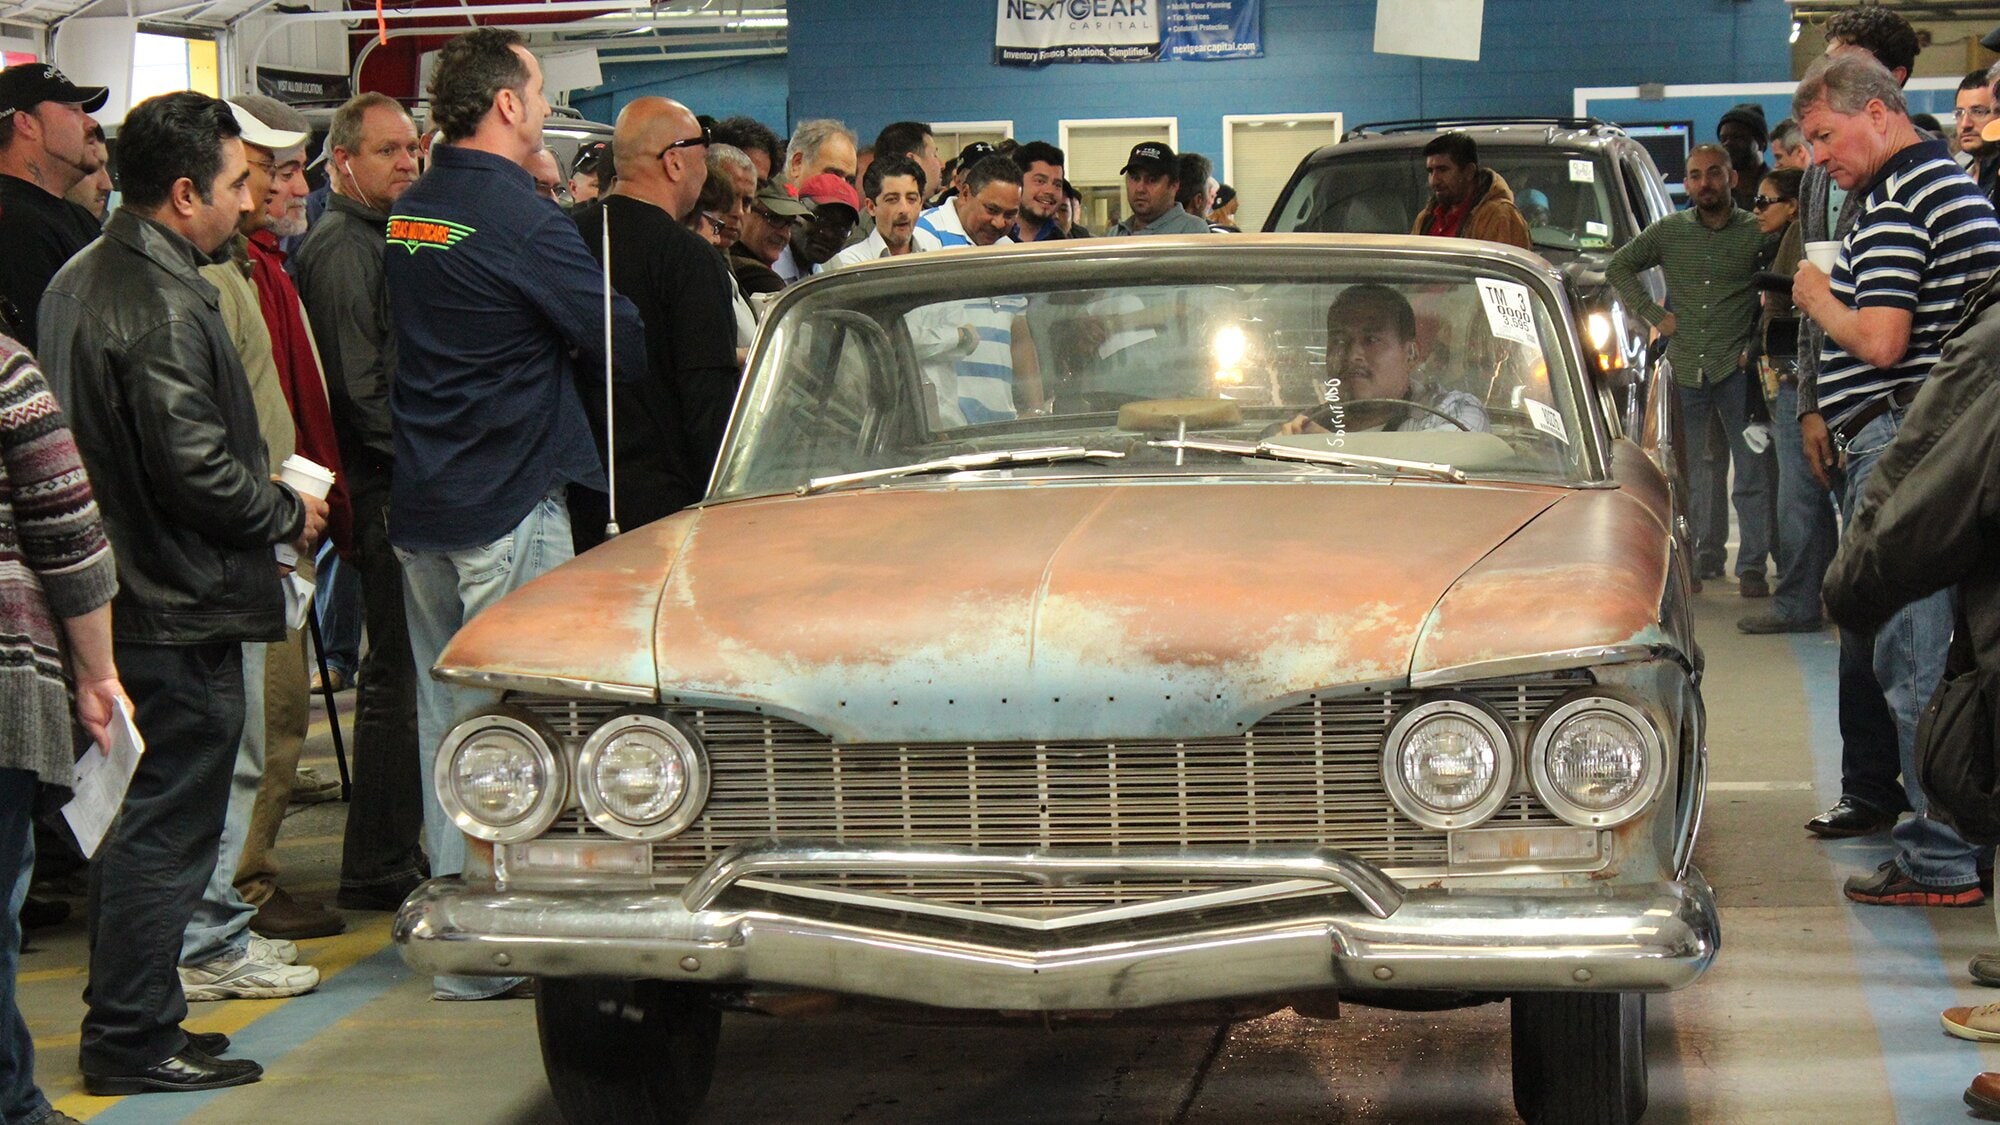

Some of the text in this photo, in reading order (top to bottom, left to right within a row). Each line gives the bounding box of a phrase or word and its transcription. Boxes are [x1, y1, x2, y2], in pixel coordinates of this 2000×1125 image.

[1006, 0, 1146, 20] NEXTGEAR
[1206, 1, 1232, 9] Planning
[1199, 23, 1229, 31] Protection
[1172, 41, 1256, 54] nextgearcapital.com
[1003, 49, 1038, 61] Inventory
[303, 82, 324, 95] LOCATIONS
[1485, 286, 1527, 312] TM 3
